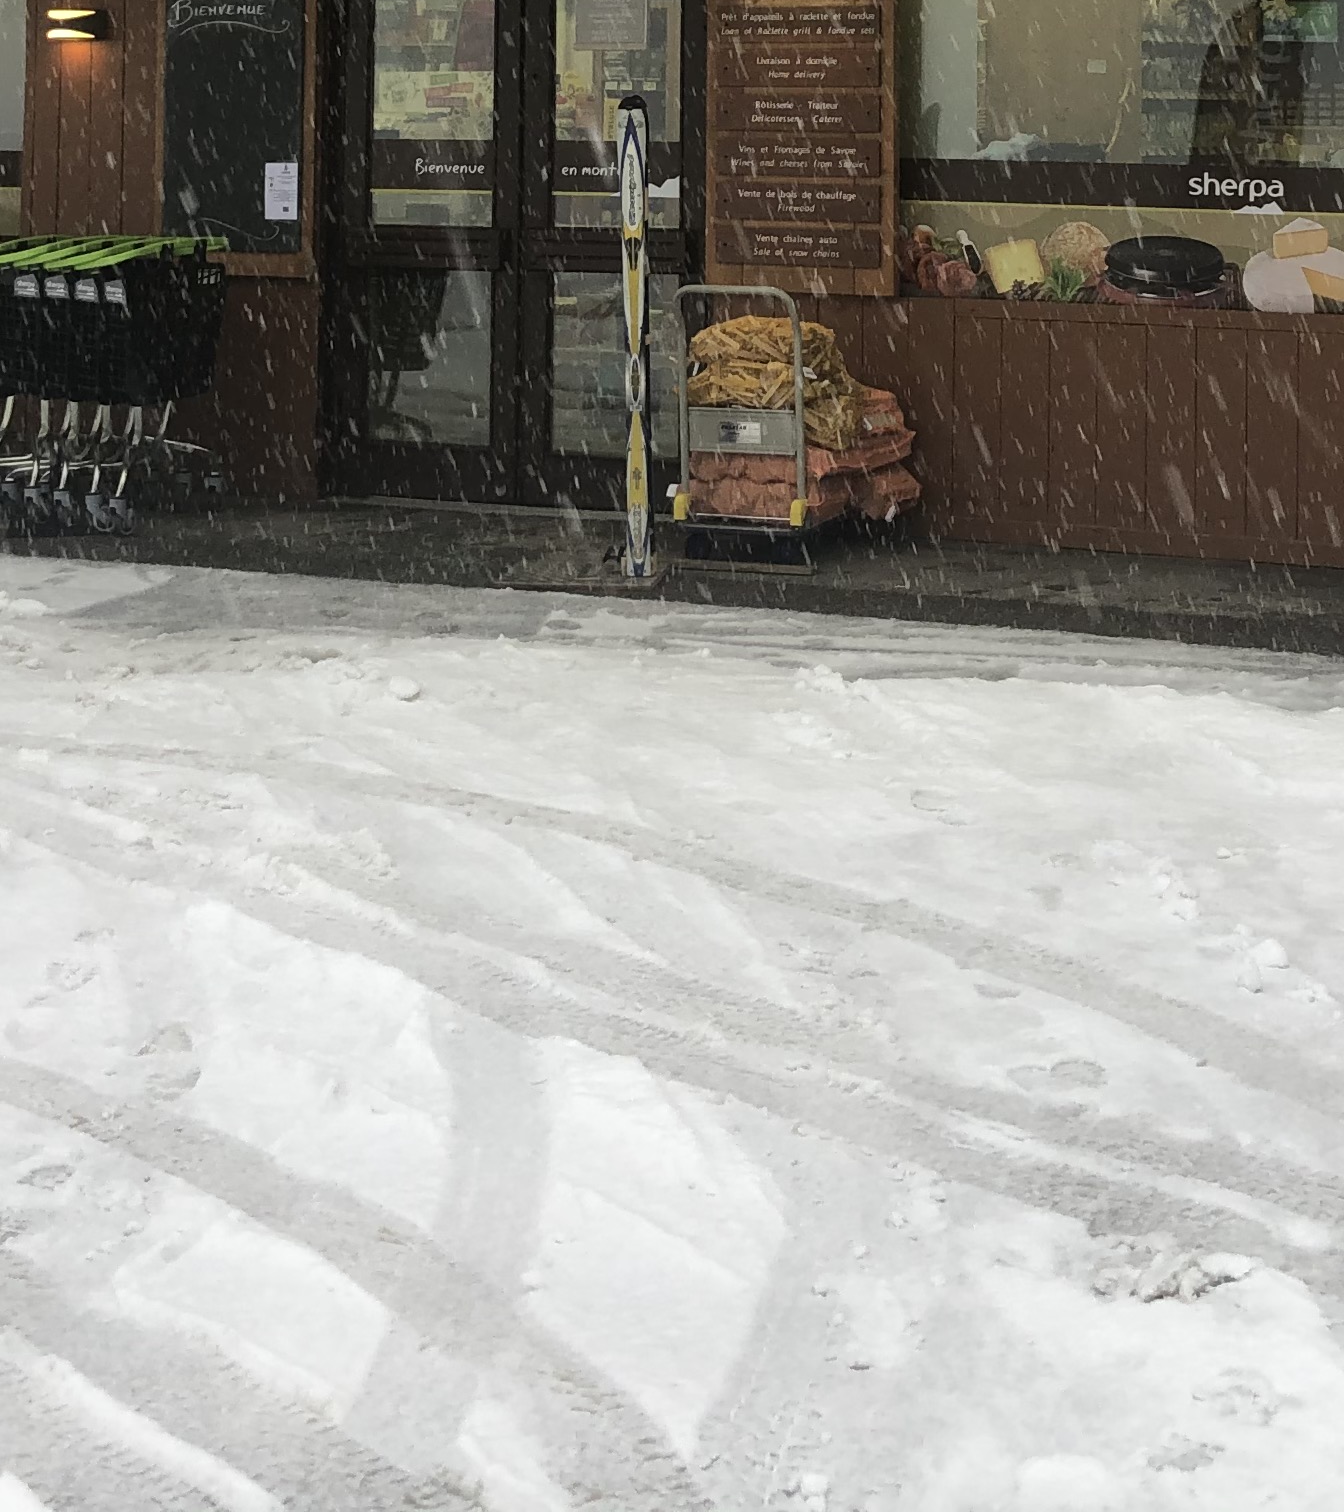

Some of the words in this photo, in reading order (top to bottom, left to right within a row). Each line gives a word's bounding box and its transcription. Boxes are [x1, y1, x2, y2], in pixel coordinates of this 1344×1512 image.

[847, 11, 875, 20] fondue
[756, 57, 791, 65] Livraison
[808, 101, 838, 109] Traiteur
[738, 145, 755, 154] Vins
[760, 146, 768, 154] et
[415, 158, 485, 175] Bienvenue
[561, 167, 577, 176] en
[1188, 172, 1284, 202] sherpa
[738, 189, 761, 198] Vente
[765, 190, 776, 198] de
[801, 191, 813, 199] de
[816, 191, 857, 202] chauffage
[778, 204, 816, 212] Firewood
[819, 236, 838, 244] auto
[753, 248, 771, 256] Sale
[813, 250, 840, 258] chains
